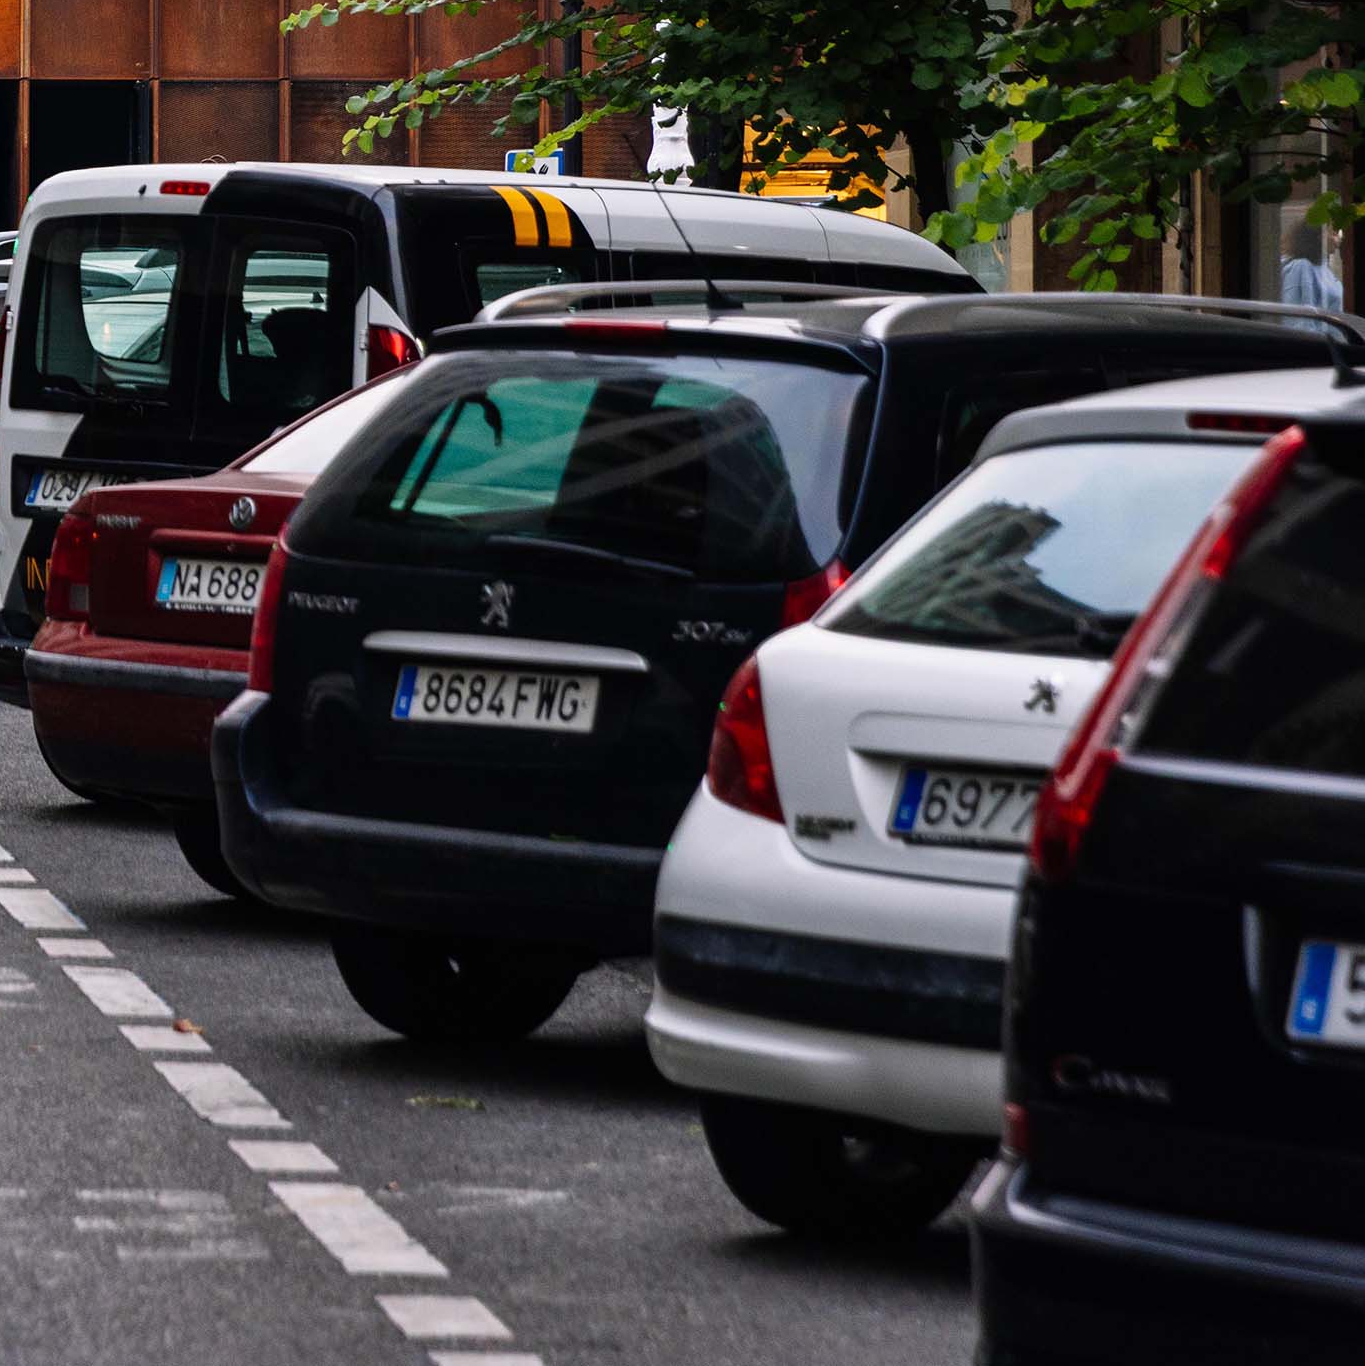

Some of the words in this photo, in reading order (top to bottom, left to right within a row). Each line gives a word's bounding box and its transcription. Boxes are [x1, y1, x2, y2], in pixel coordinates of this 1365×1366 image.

[171, 564, 202, 597] NA
[207, 566, 259, 601] 688
[289, 591, 360, 613] PEUGEOT
[423, 672, 506, 715] 8684
[511, 677, 580, 721] FWG
[922, 778, 1037, 830] 6977
